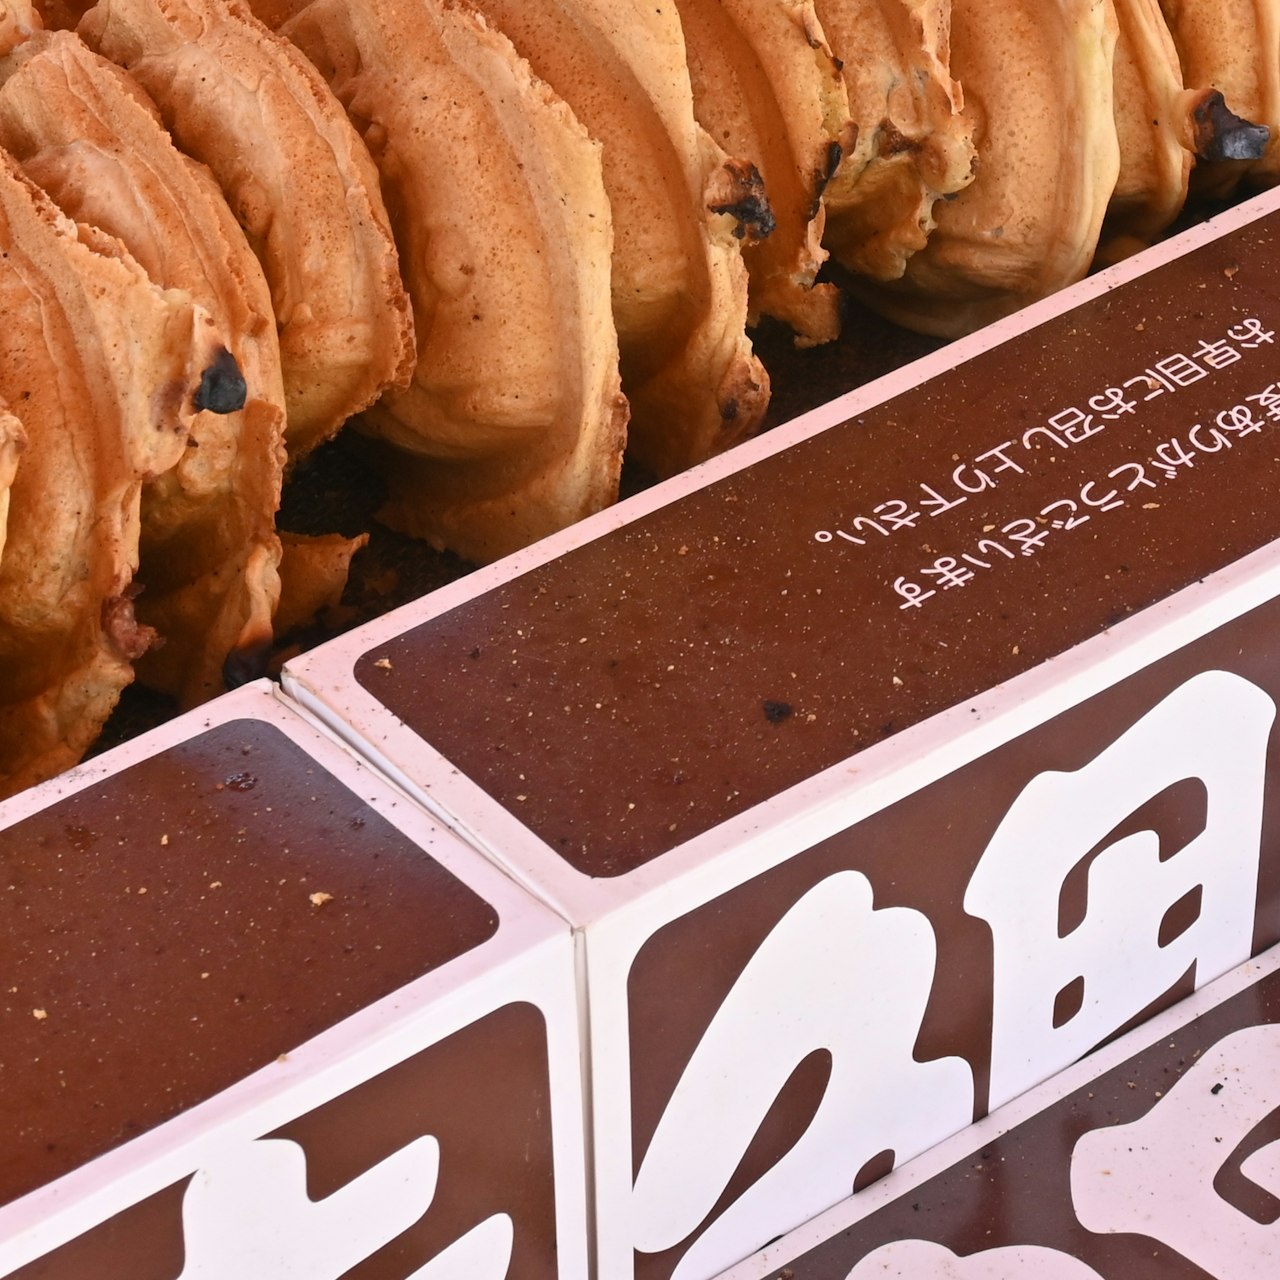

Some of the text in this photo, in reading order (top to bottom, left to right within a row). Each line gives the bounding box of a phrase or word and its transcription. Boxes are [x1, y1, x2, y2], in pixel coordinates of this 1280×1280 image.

[814, 318, 1274, 545] お早目にお召し上り下さい。
